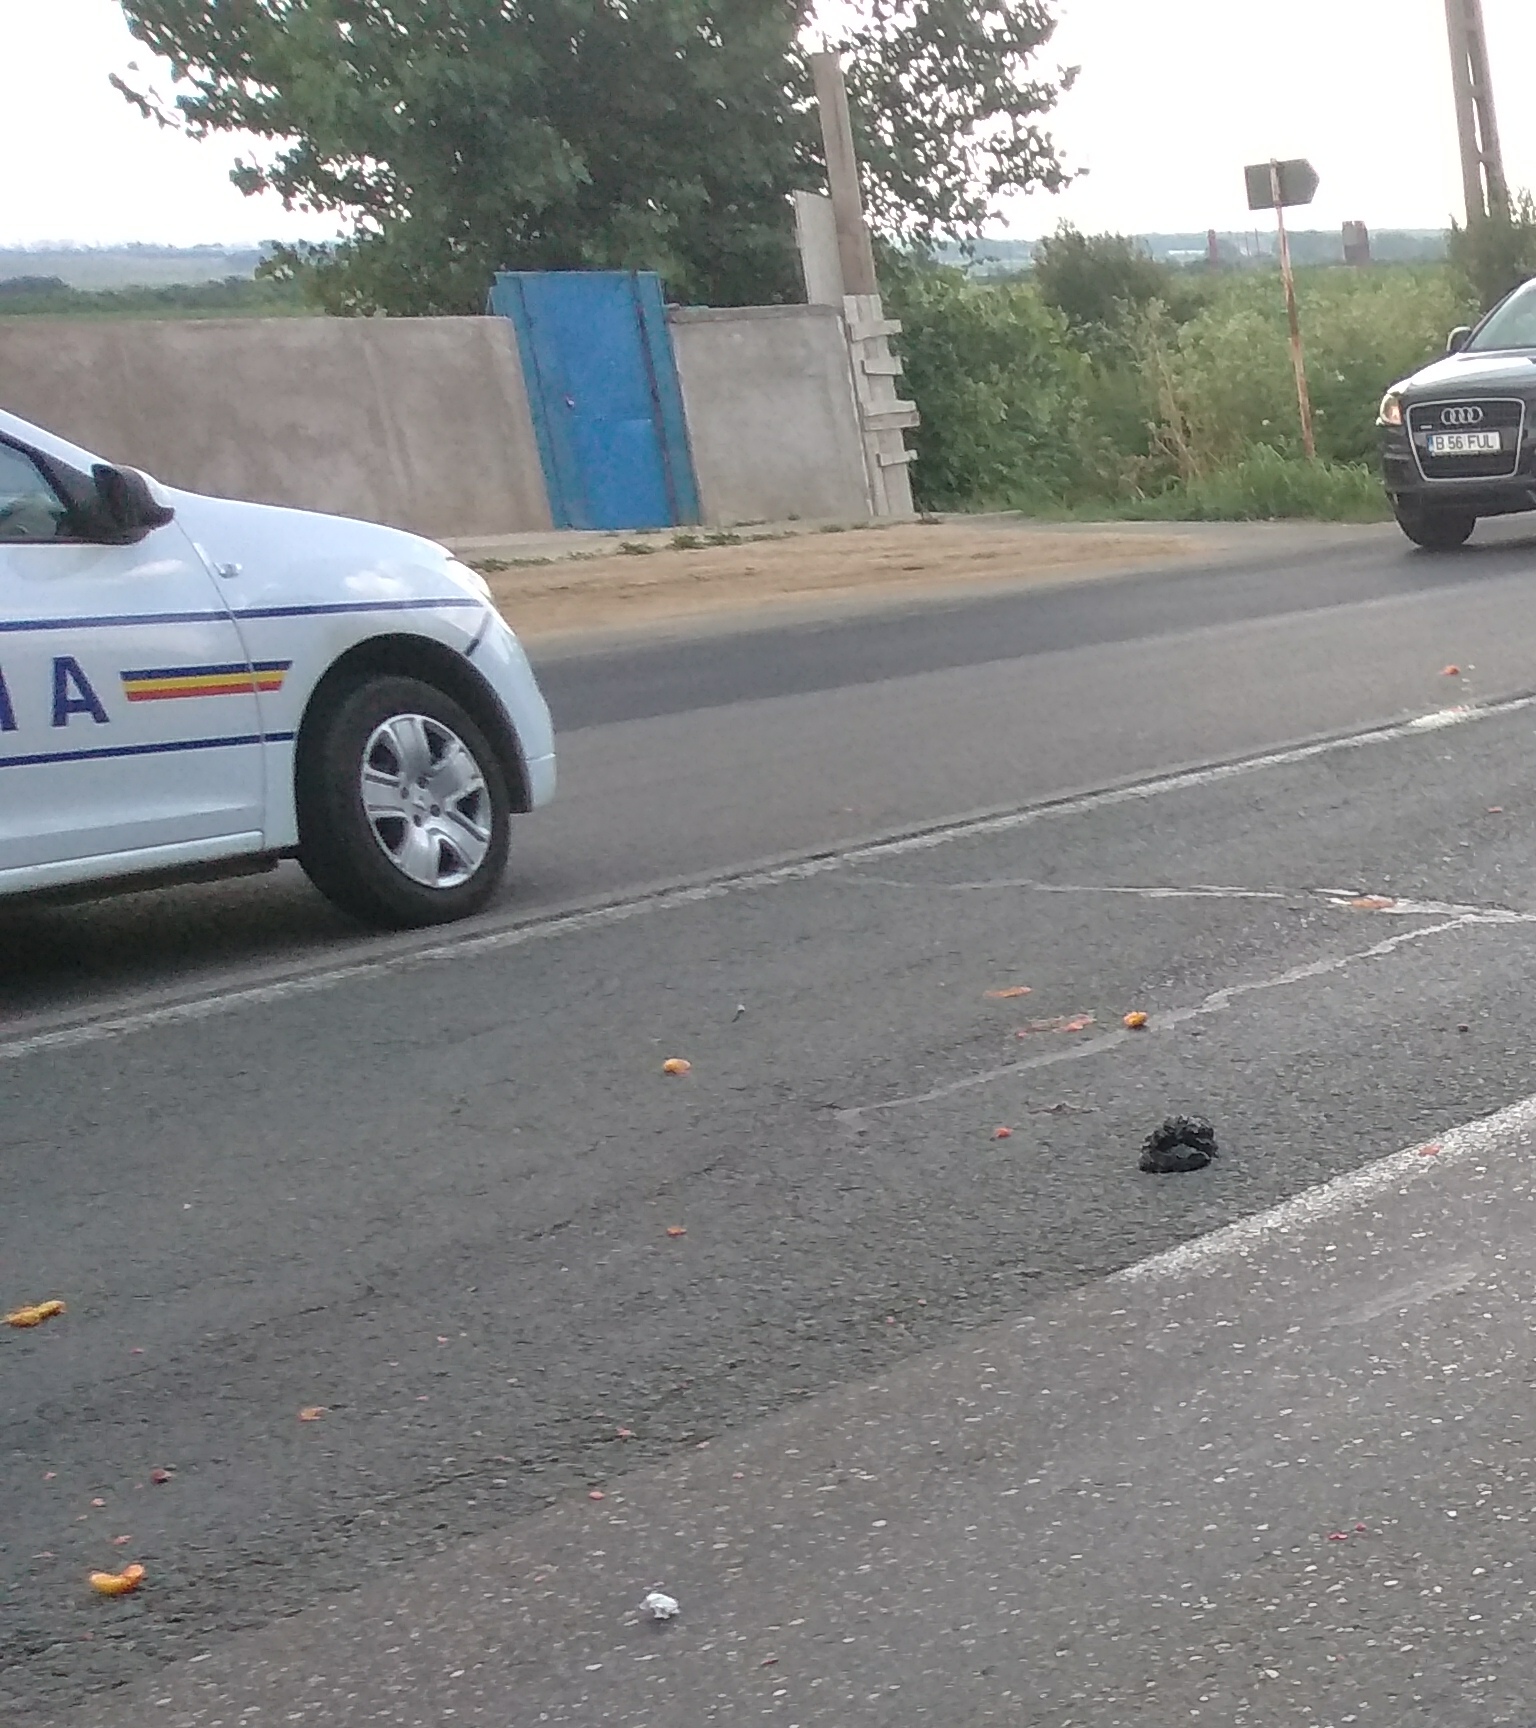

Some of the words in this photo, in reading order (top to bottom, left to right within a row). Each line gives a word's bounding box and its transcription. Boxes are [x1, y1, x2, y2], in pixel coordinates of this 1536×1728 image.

[1436, 436, 1445, 451] B
[1448, 435, 1464, 450] 56
[1467, 434, 1494, 449] FUL
